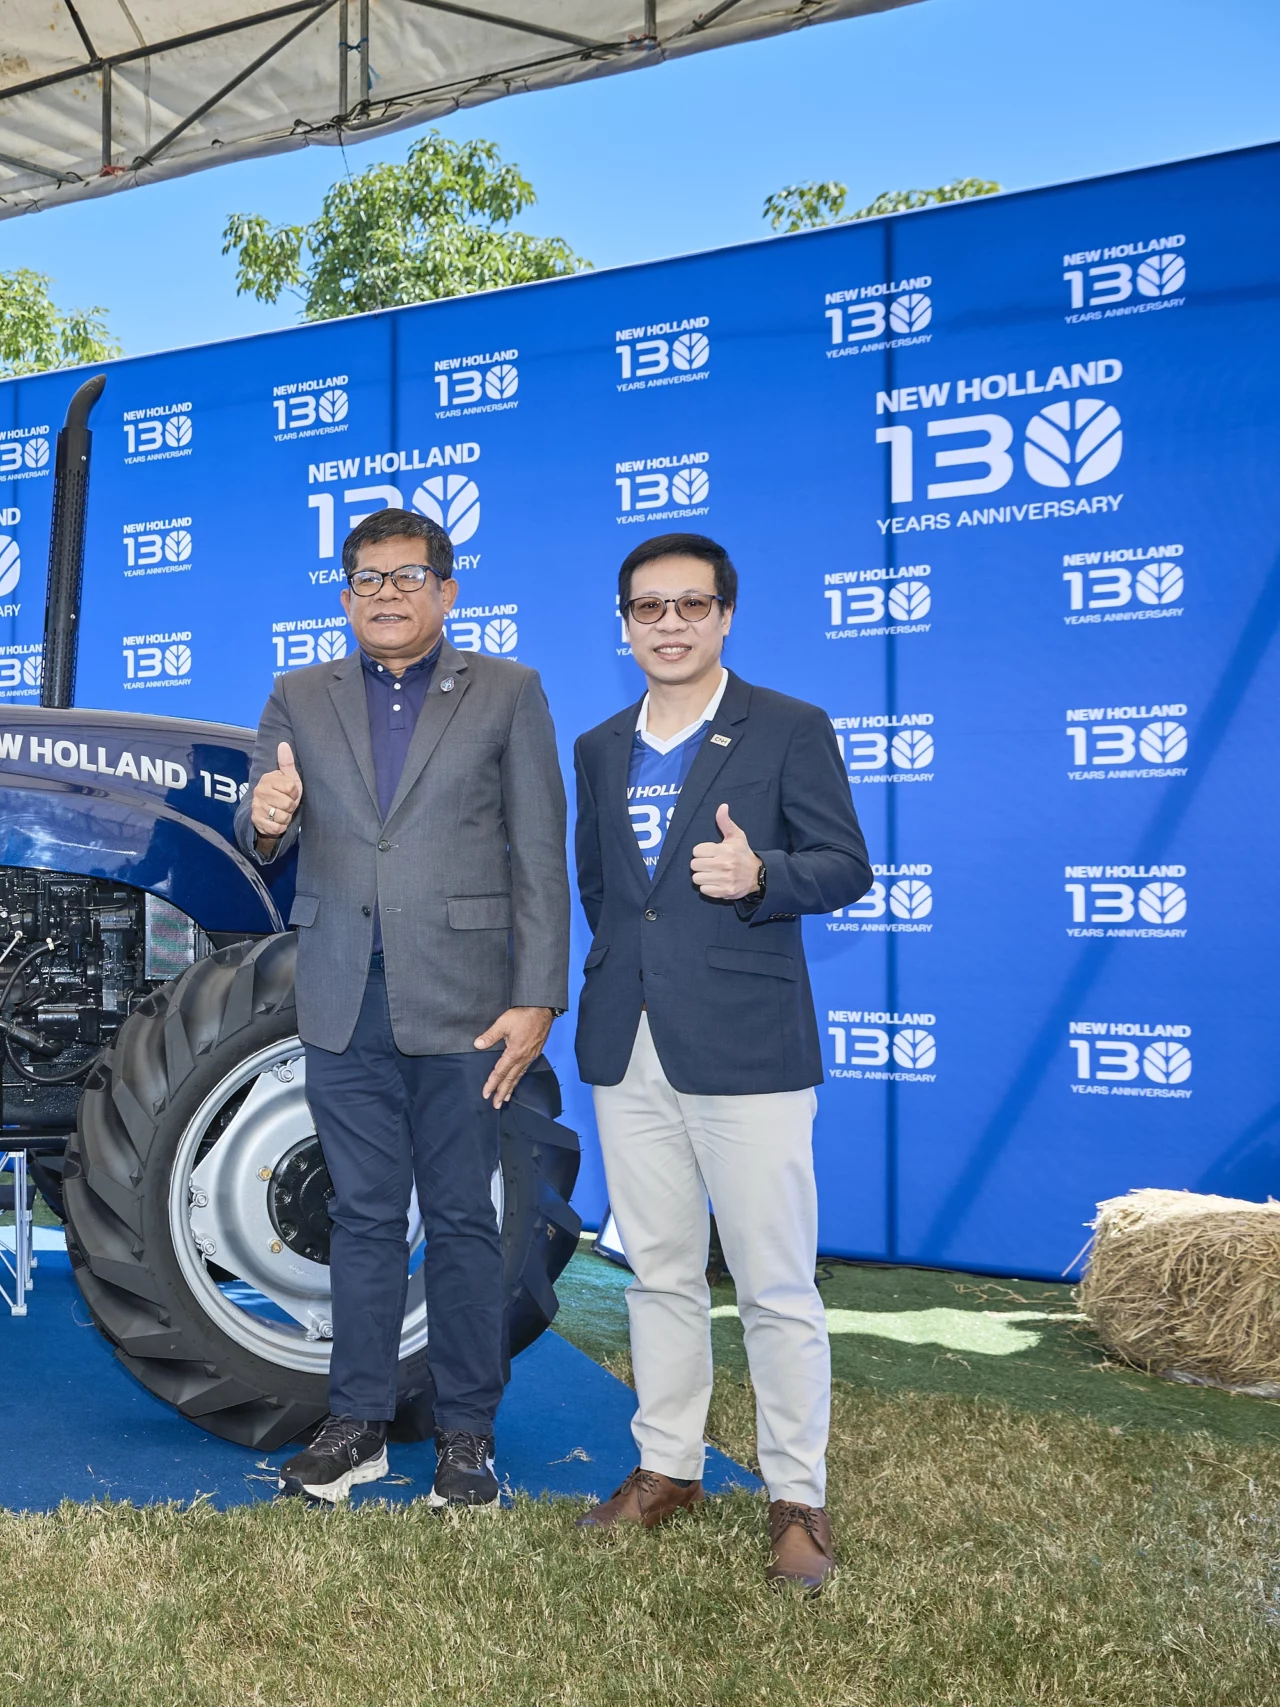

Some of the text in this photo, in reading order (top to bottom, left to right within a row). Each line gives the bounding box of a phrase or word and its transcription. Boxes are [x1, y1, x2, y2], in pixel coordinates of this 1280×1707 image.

[1064, 234, 1185, 266] NEW HOLLAND
[825, 276, 932, 305] NEW HOLLAND
[1065, 298, 1185, 323] YEARS ANNIVERSARY
[616, 317, 709, 341] NEW HOLLAND
[826, 335, 932, 358] YEARS ANNIVERSARY
[435, 349, 518, 371] NEW HOLLAND
[274, 375, 348, 396] NEW HOLLAND
[617, 372, 709, 391] YEARS ANNIVERSARY
[876, 359, 1122, 414] NEW HOLLAND
[124, 402, 192, 421] NEW HOLLAND
[436, 401, 518, 419] YEARS ANNIVERSARY
[8, 425, 49, 439] HOLLAND
[274, 424, 348, 441] YEARS ANNIVERSARY
[124, 449, 192, 464] YEARS ANNIVERSARY
[308, 442, 481, 483] NEW HOLLAND
[616, 452, 709, 473] NEW HOLLAND
[8, 470, 49, 480] ANNIVERSARY
[616, 508, 709, 524] YEARS ANNIVERSARY
[877, 494, 1123, 534] YEARS ANNIVERSARY
[124, 517, 192, 534] NEW HOLLAND
[1063, 544, 1183, 566] NEW HOLLAND
[147, 564, 191, 574] ANNIVERSARY
[825, 565, 931, 585] NEW HOLLAND
[461, 604, 518, 618] HOLLAND
[1064, 608, 1183, 624] YEARS ANNIVERSARY
[272, 616, 347, 633] NEW HOLLAND
[825, 624, 930, 639] YEARS ANNIVERSARY
[123, 632, 191, 646] NEW HOLLAND
[6, 644, 42, 655] HOLLAN
[146, 679, 191, 687] ANNIVERSARY
[862, 713, 934, 728] HOLLAND
[1067, 704, 1187, 721] NEW HOLLAND
[30, 736, 188, 790] HOLLAND
[863, 773, 934, 783] ANNIVERSARY
[1068, 768, 1187, 780] YEARS ANNIVERSARY
[635, 783, 683, 799] HOLL
[870, 864, 933, 876] OLLAND
[1065, 865, 1186, 878] NEW HOLLAND
[826, 923, 933, 932] YEARS ANNIVERSARY
[1067, 929, 1187, 937] YEARS ANNIVERSARY
[828, 1010, 936, 1025] NEW HOLLAND
[1070, 1022, 1191, 1037] NEW HOLLAND
[829, 1070, 936, 1082] YEARS ANNIVERSARY
[1071, 1085, 1192, 1098] YEARS ANNIVERSARY
